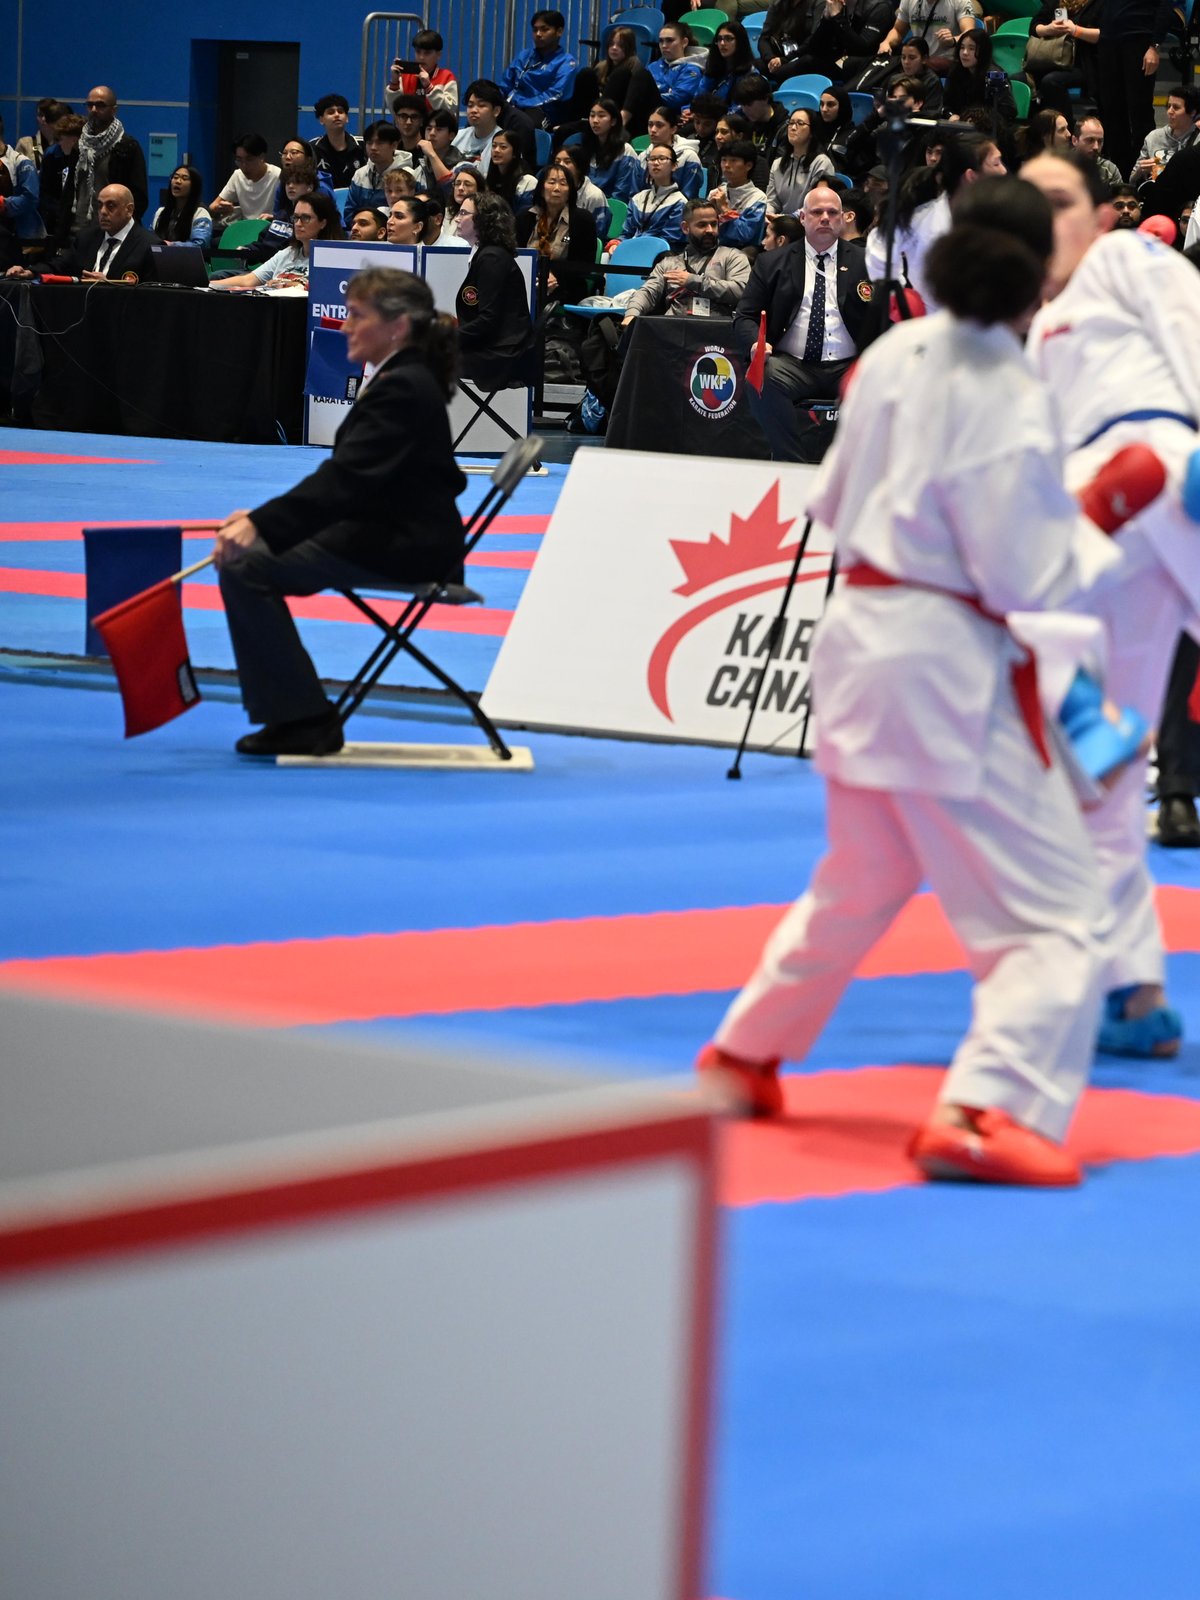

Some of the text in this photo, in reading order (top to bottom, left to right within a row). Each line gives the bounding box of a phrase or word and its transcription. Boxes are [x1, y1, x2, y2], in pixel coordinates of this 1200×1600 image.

[704, 345, 725, 354] WORLD
[700, 374, 727, 390] WKF
[689, 397, 737, 419] KARATE FEDERATION
[725, 613, 816, 662] KAR
[706, 665, 812, 713] CANA
